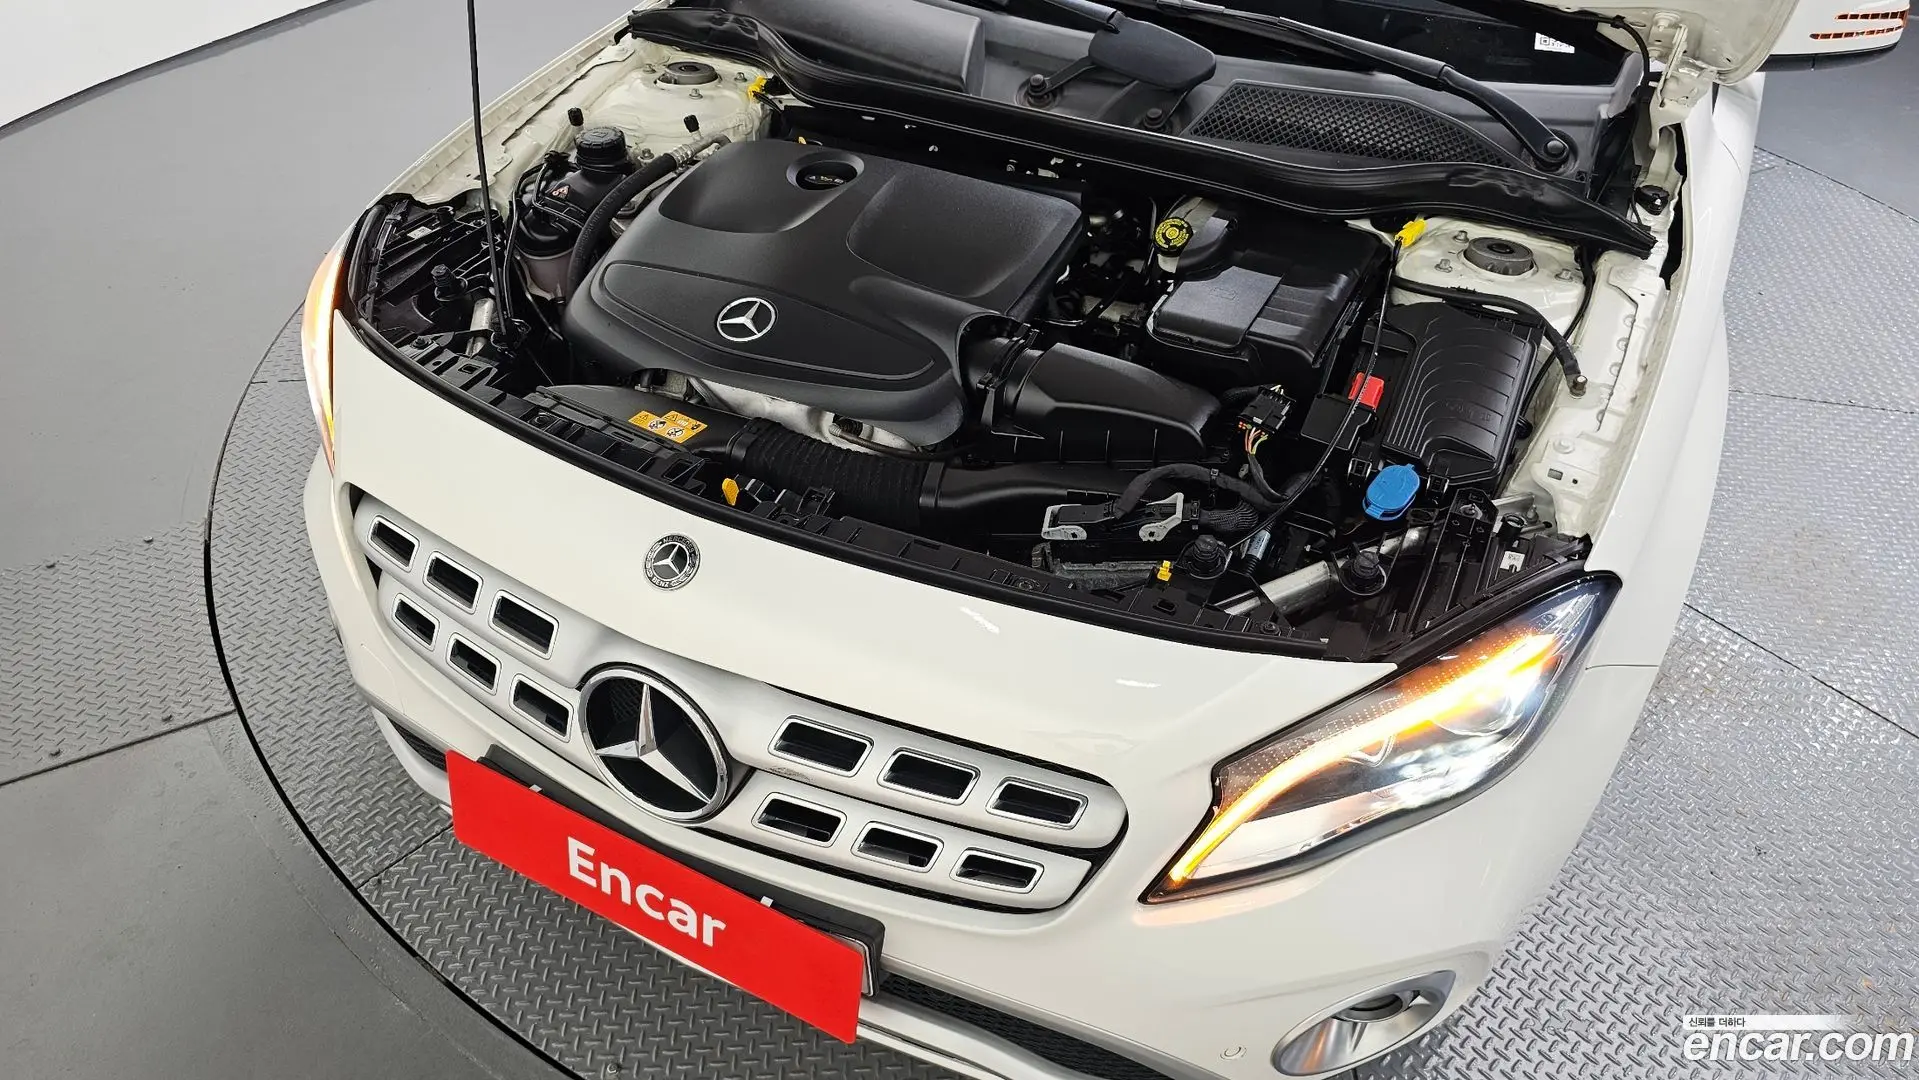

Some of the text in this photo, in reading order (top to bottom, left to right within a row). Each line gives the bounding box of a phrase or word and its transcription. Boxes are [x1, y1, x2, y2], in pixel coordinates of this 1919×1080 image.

[663, 536, 695, 553] MERCEDES
[651, 576, 670, 588] BENZ
[567, 836, 727, 947] Encar
